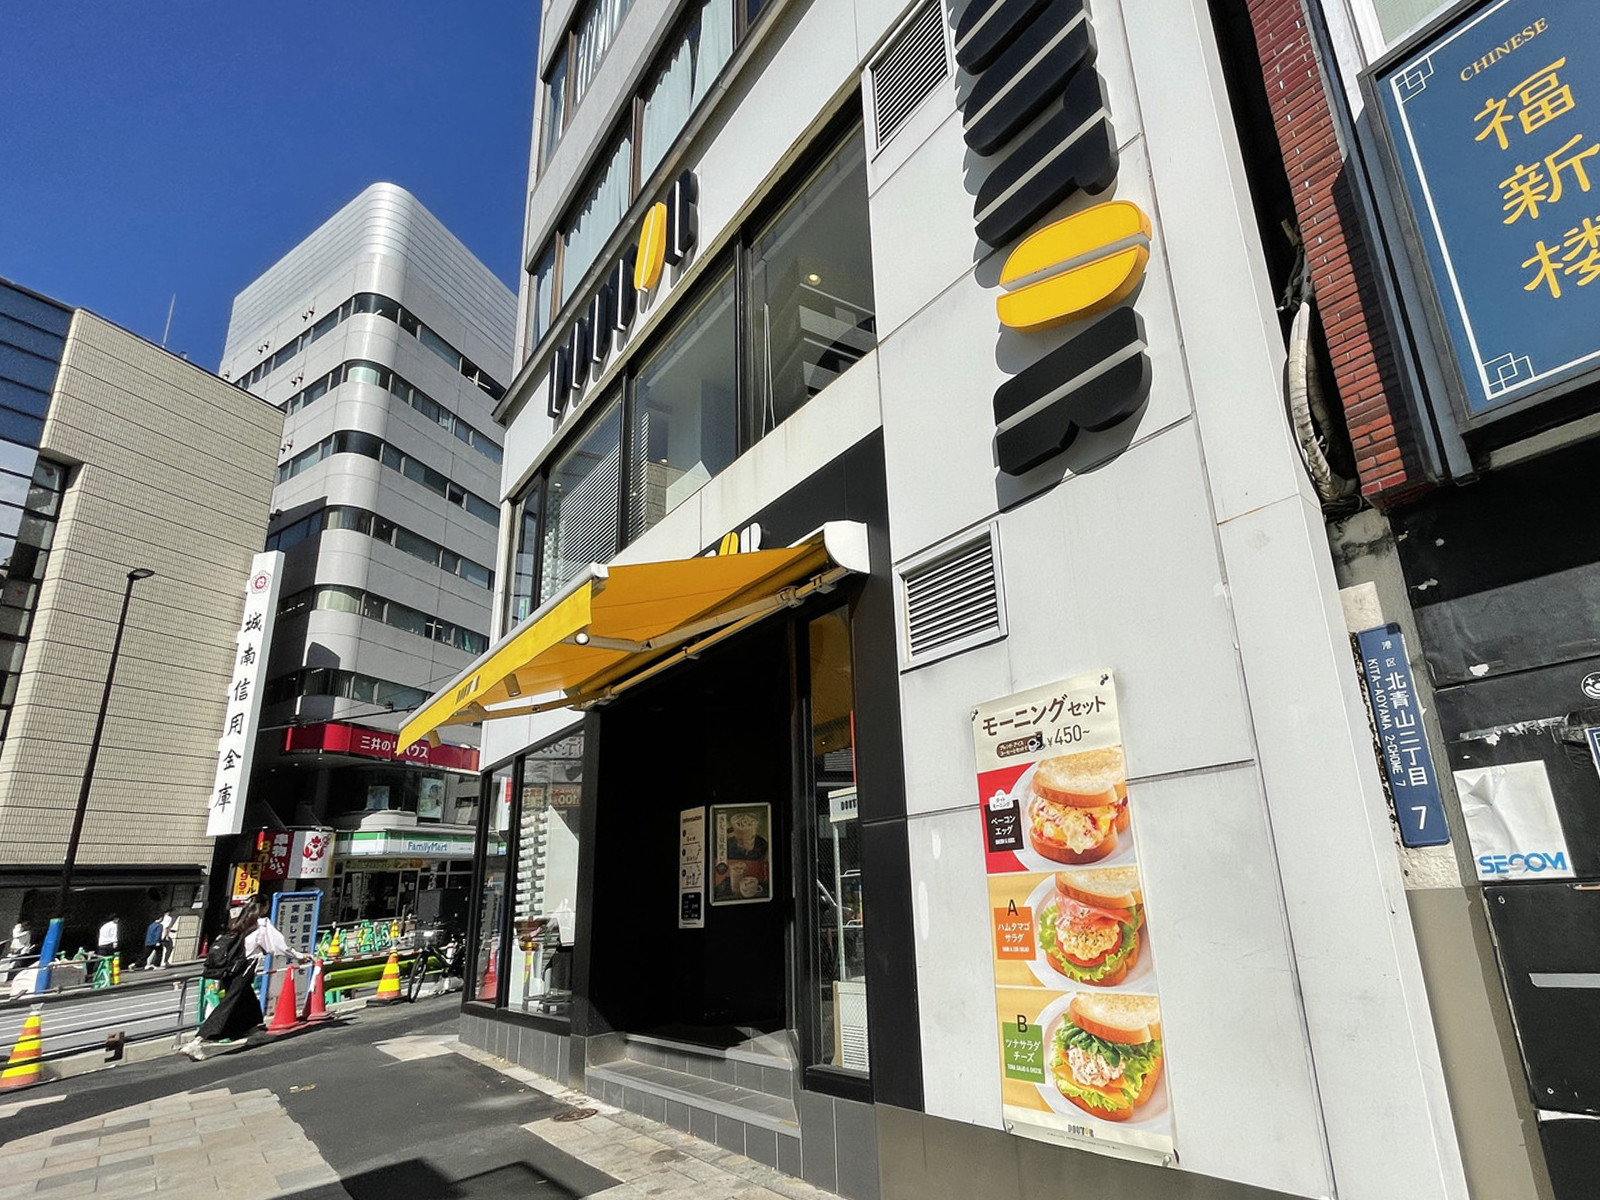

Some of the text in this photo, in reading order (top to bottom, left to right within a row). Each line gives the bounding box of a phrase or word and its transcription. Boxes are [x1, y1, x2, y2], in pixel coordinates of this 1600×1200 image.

[1459, 17, 1549, 82] CHINESE
[1473, 56, 1600, 299] 福新楼
[214, 612, 262, 814] 城南信用金庫
[982, 693, 1107, 737] モーニングセット
[1367, 658, 1407, 788] KITA-AOYAMA 2-CHOME 7
[1385, 671, 1429, 787] 北青山二丁目
[991, 815, 1017, 825] ベーコン
[1410, 805, 1427, 830] 7
[995, 825, 1014, 836] エッグ
[407, 841, 448, 854] FamilyMart
[1478, 851, 1568, 874] SECOM
[1007, 898, 1019, 917] A
[997, 921, 1031, 932] ハムタマゴ
[1004, 933, 1025, 943] サラダ
[1016, 1014, 1028, 1033] B
[1005, 1038, 1041, 1052] ツナサラダ
[1013, 1050, 1035, 1063] チーズ
